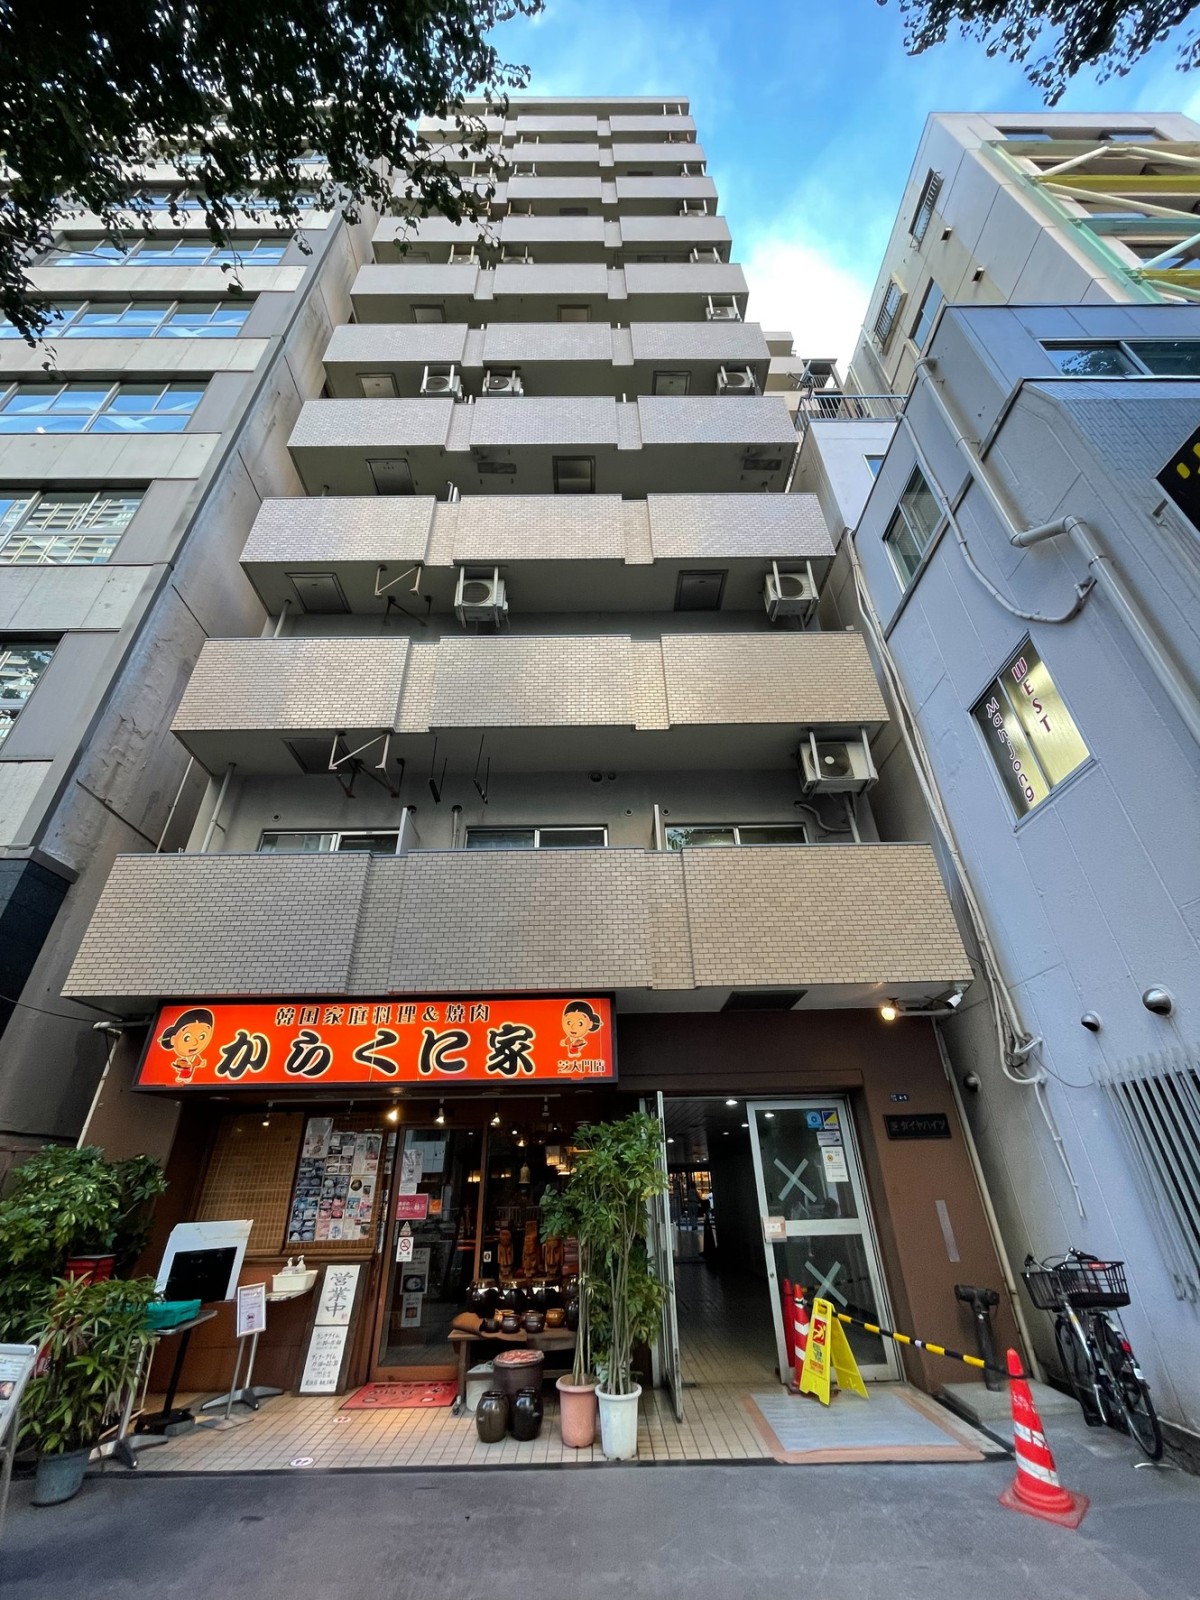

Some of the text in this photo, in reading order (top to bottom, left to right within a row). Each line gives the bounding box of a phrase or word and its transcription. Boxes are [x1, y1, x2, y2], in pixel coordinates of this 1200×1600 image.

[1011, 657, 1052, 733] WEST
[986, 697, 1035, 802] Mahjong
[216, 1024, 536, 1078] からくに家
[325, 1272, 354, 1317] 営業中
